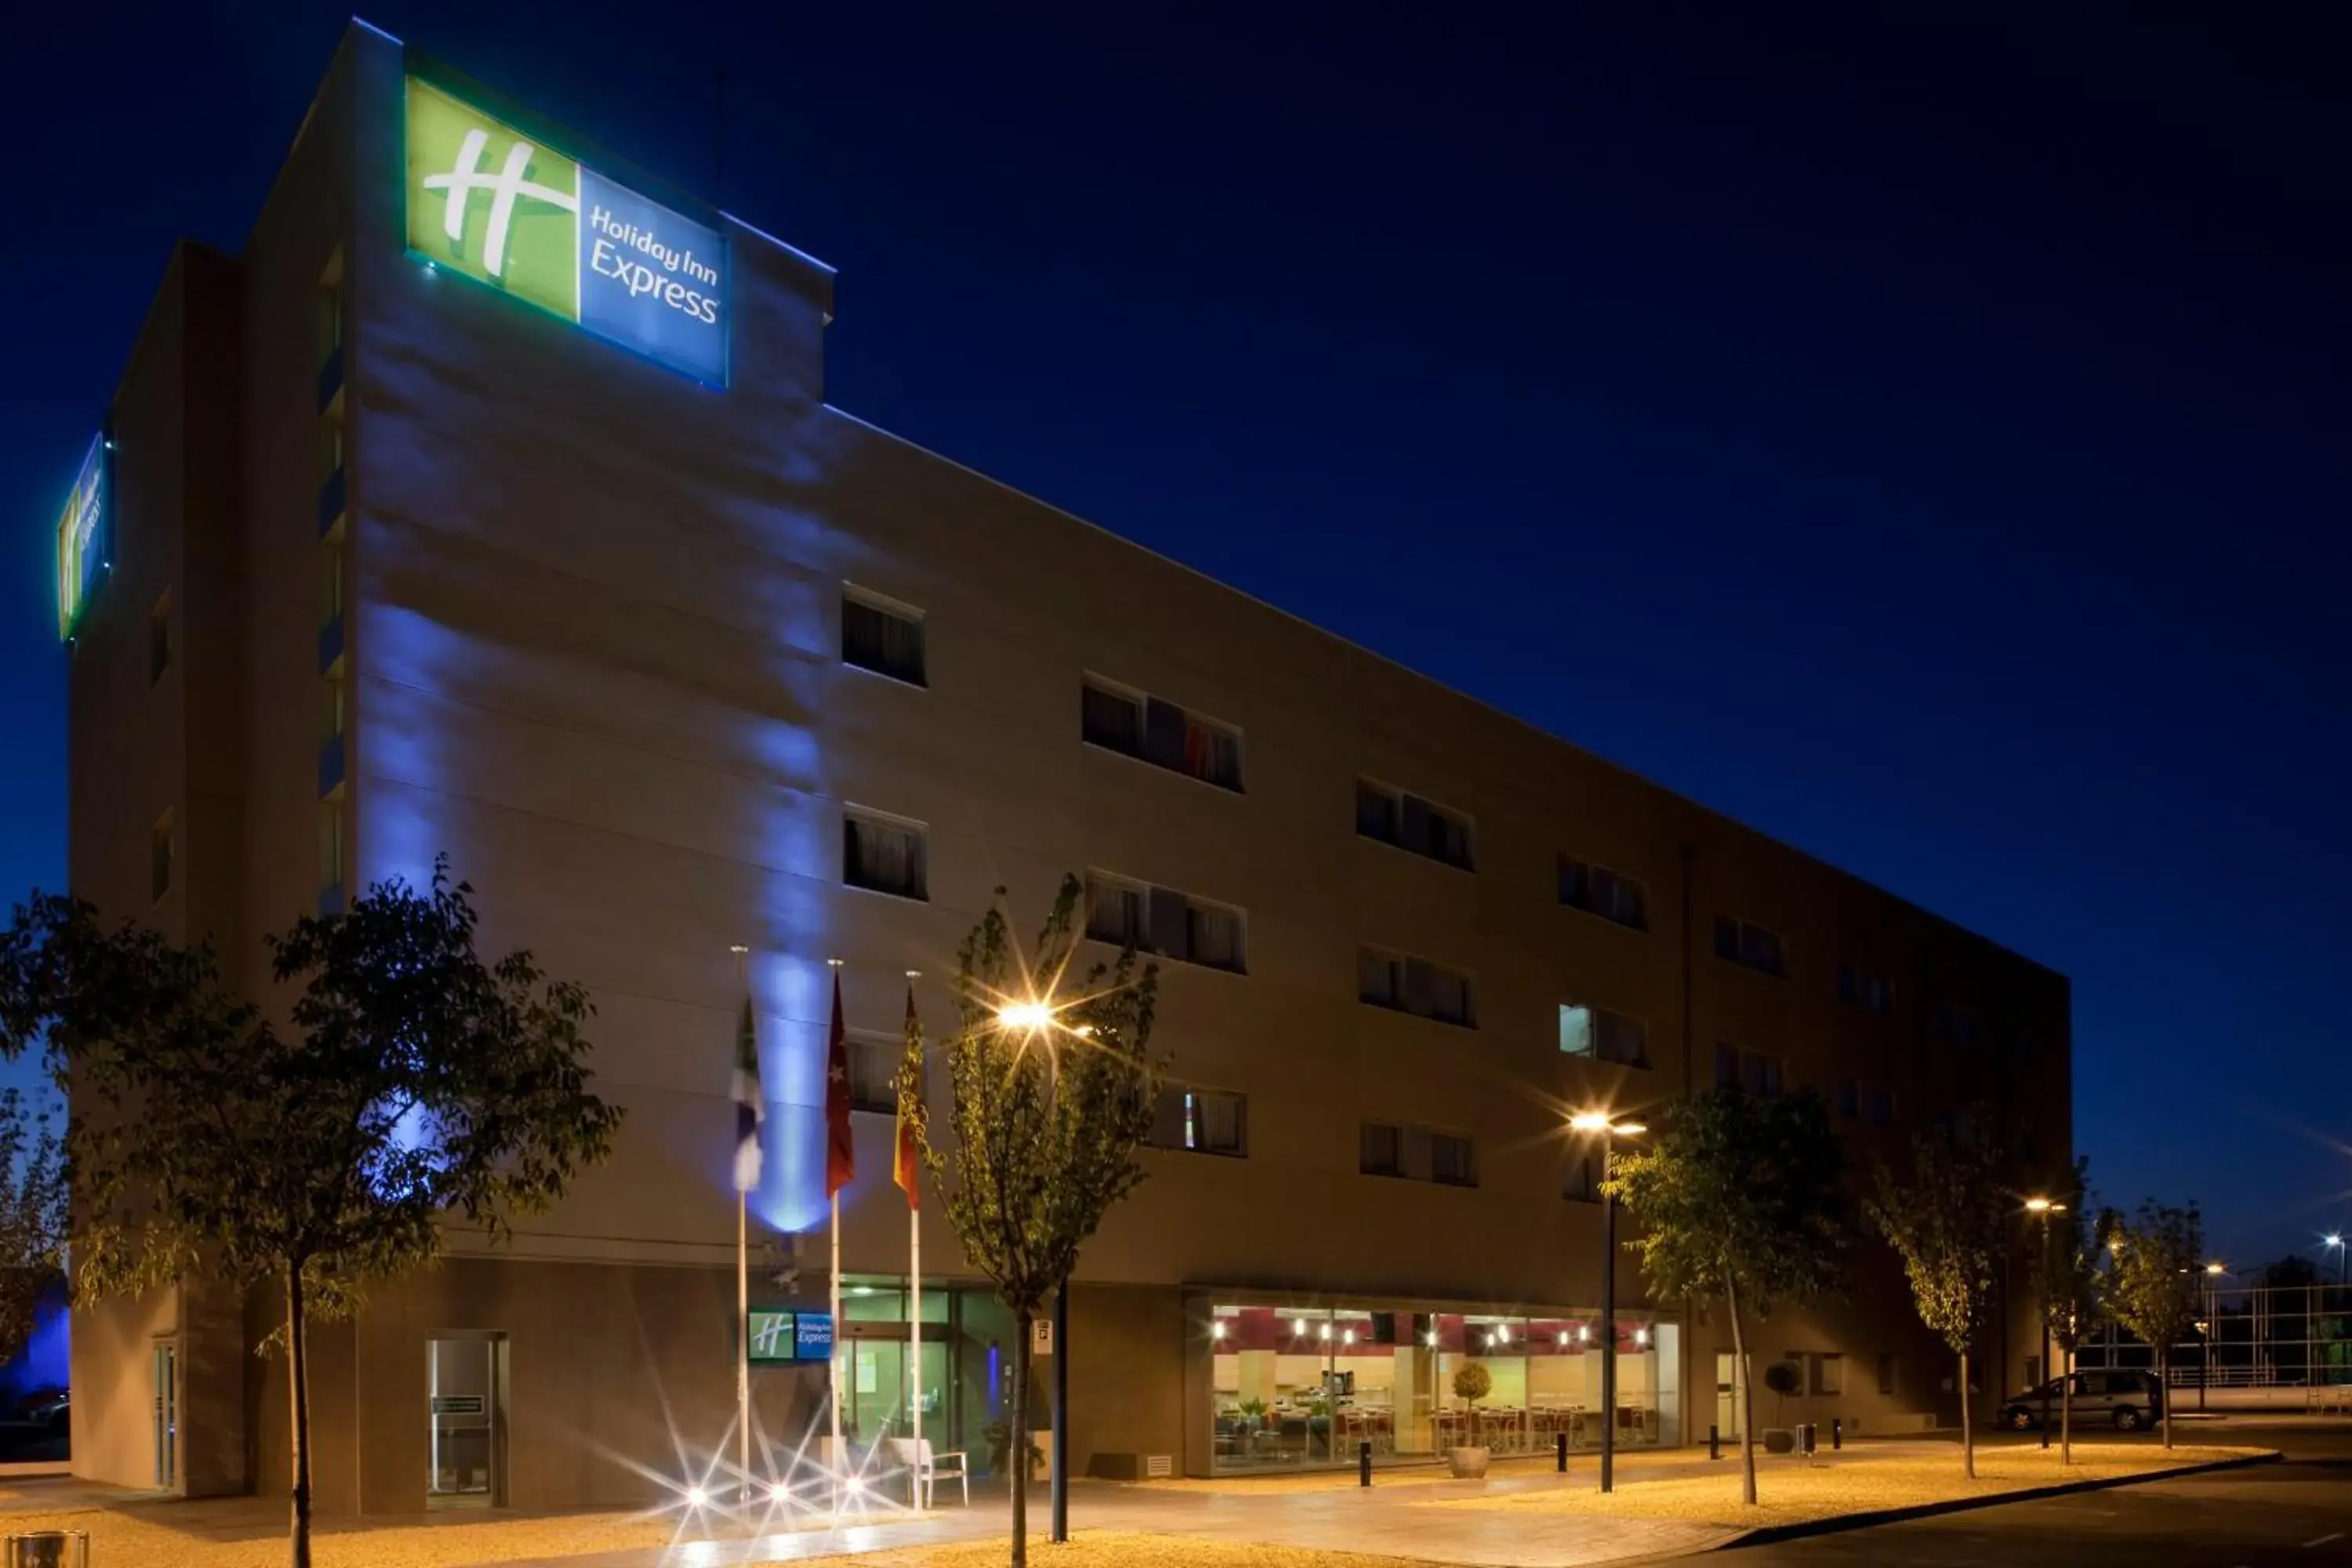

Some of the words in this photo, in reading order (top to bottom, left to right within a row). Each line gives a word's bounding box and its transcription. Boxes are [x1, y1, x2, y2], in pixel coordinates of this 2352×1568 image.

[423, 128, 579, 277] H
[590, 204, 681, 272] Holiday
[683, 250, 717, 287] Inn
[591, 238, 719, 324] Express
[753, 1313, 793, 1356] H
